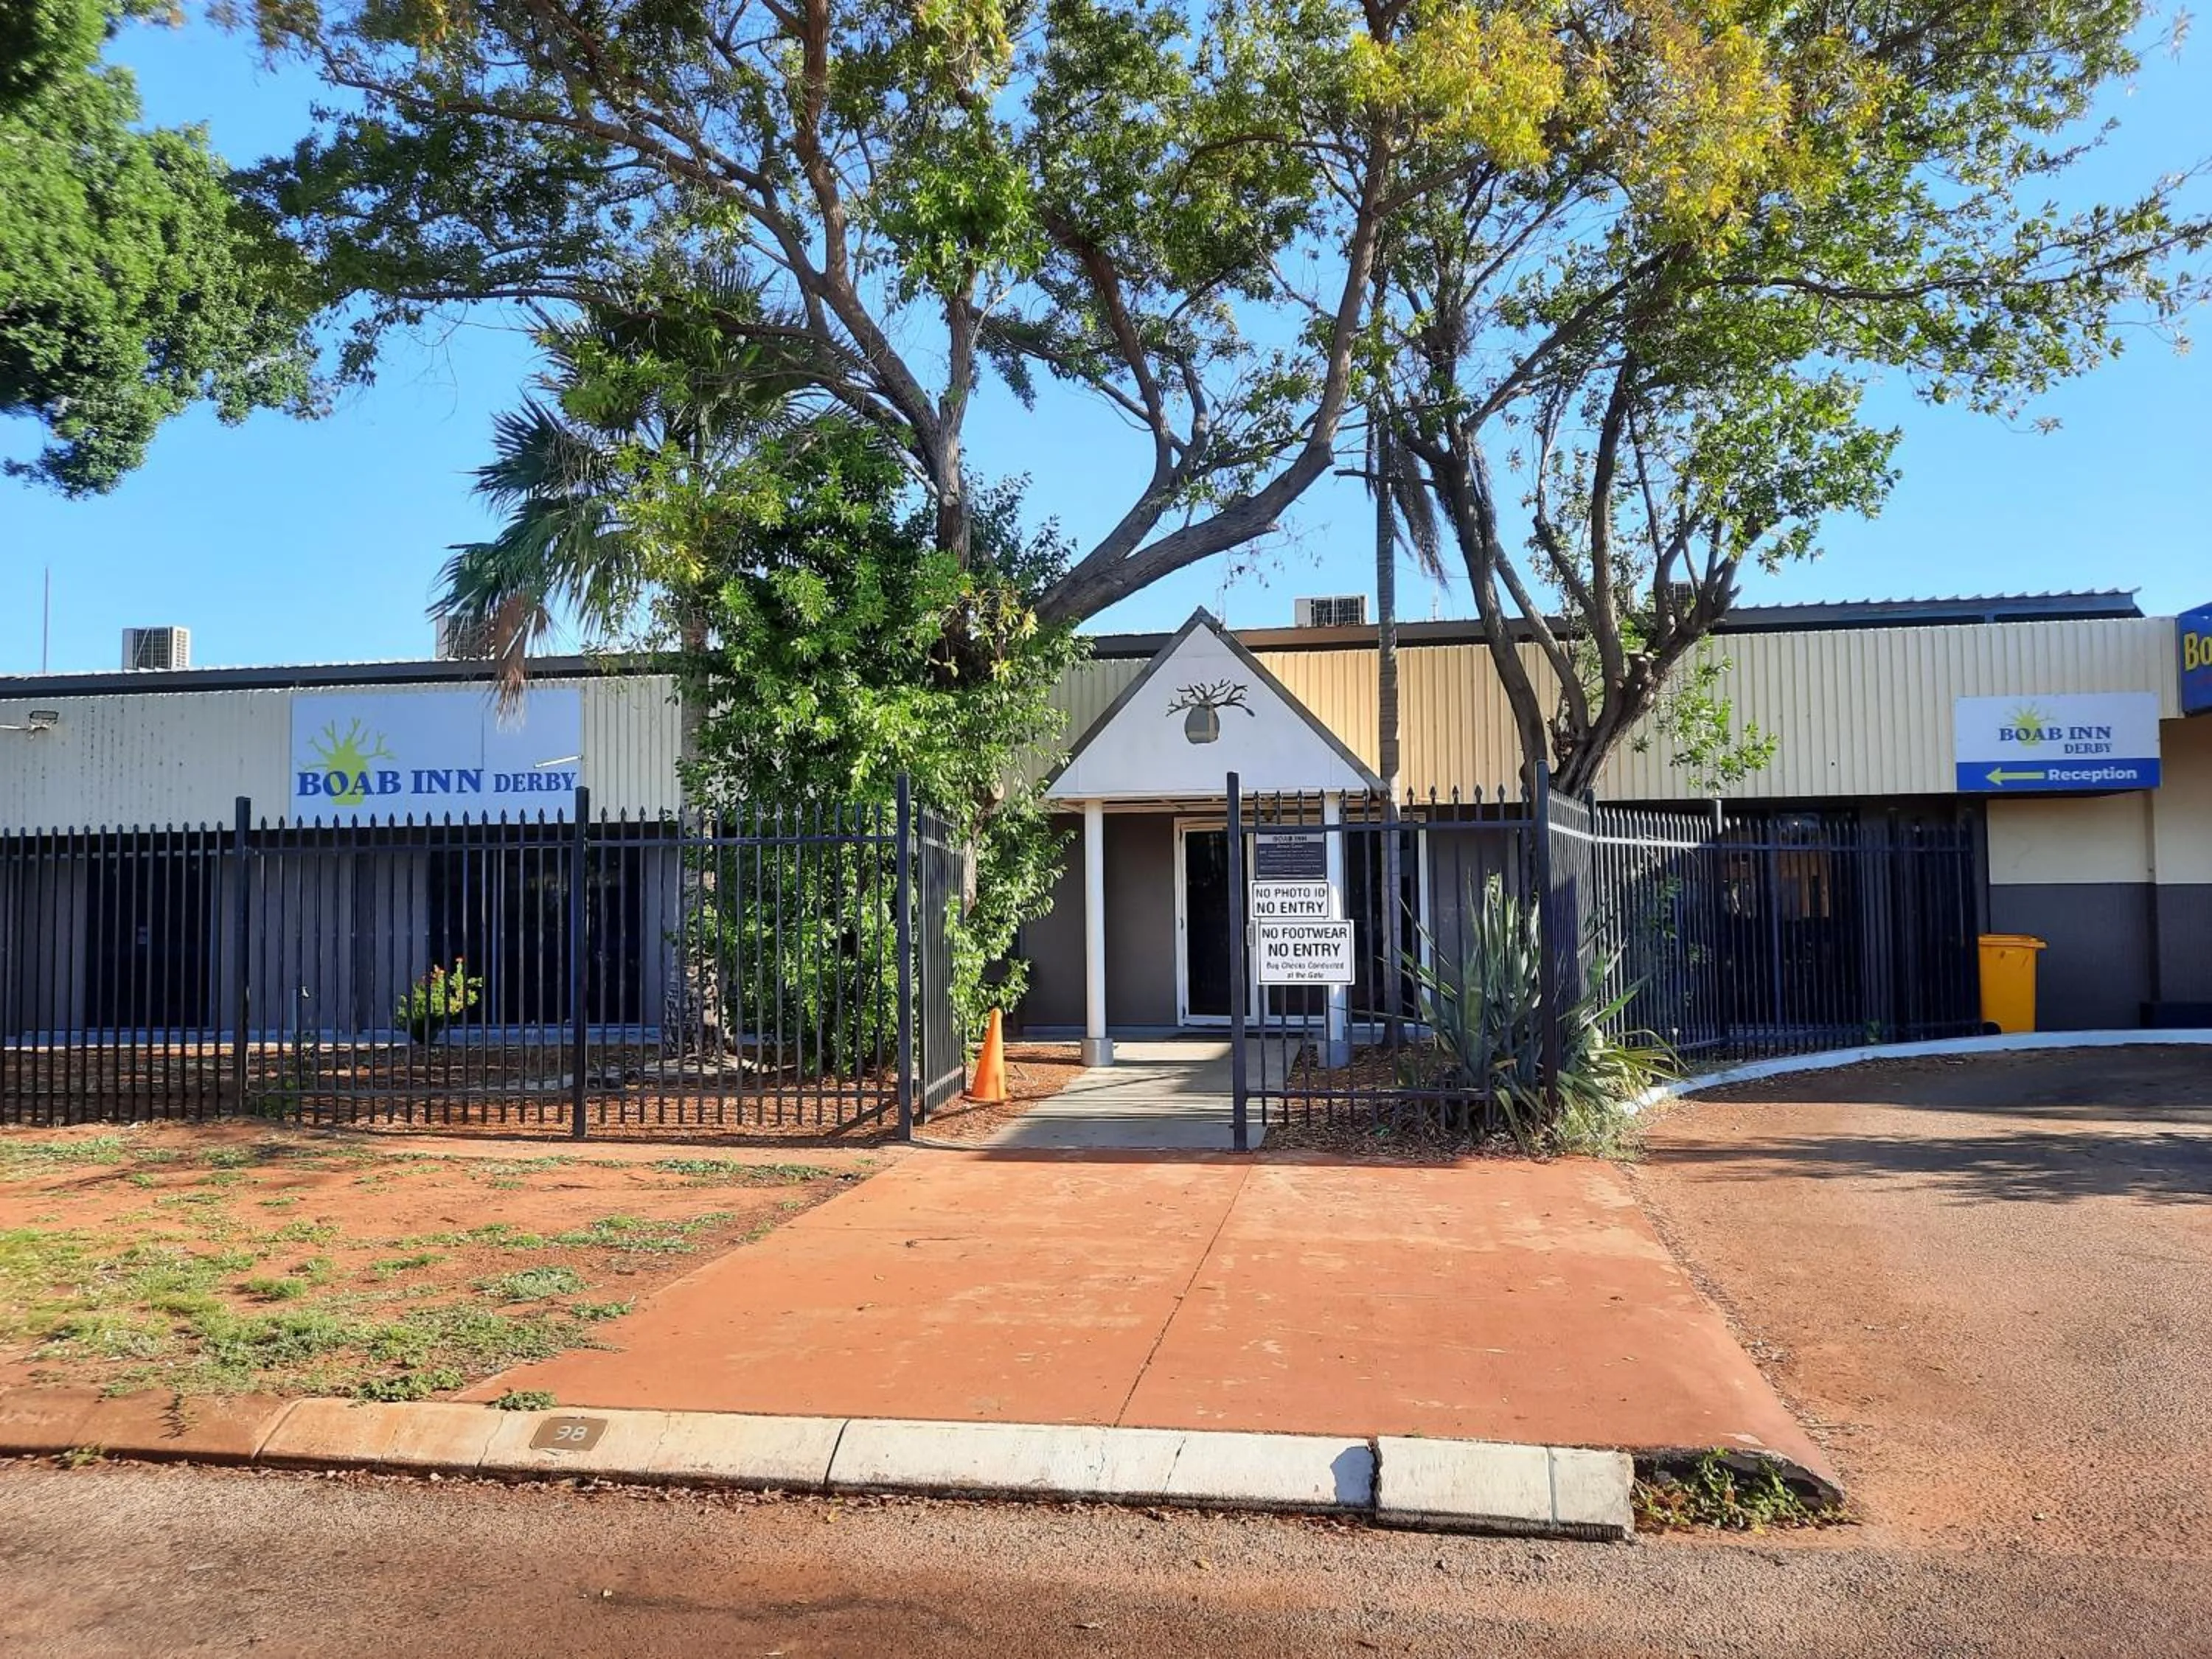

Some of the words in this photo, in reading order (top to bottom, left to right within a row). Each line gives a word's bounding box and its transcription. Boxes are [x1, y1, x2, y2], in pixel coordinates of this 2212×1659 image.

[2000, 727, 2063, 742] BOAB
[2069, 726, 2112, 740] INN
[2064, 742, 2112, 754] DERBY
[2048, 767, 2138, 782] Reception
[297, 770, 402, 796] BOAB
[411, 769, 484, 794] INN
[493, 772, 577, 793] DERBY
[1256, 888, 1270, 898] NO
[1275, 887, 1310, 898] PHOTO
[1315, 887, 1325, 897] ID
[1256, 902, 1275, 914] NO
[1280, 902, 1324, 914] ENTRY
[1262, 928, 1278, 939] NO
[1282, 927, 1347, 939] FOOTWEAR
[1268, 944, 1288, 956] NO
[1293, 944, 1341, 956] ENTRY
[554, 1425, 588, 1441] 98
